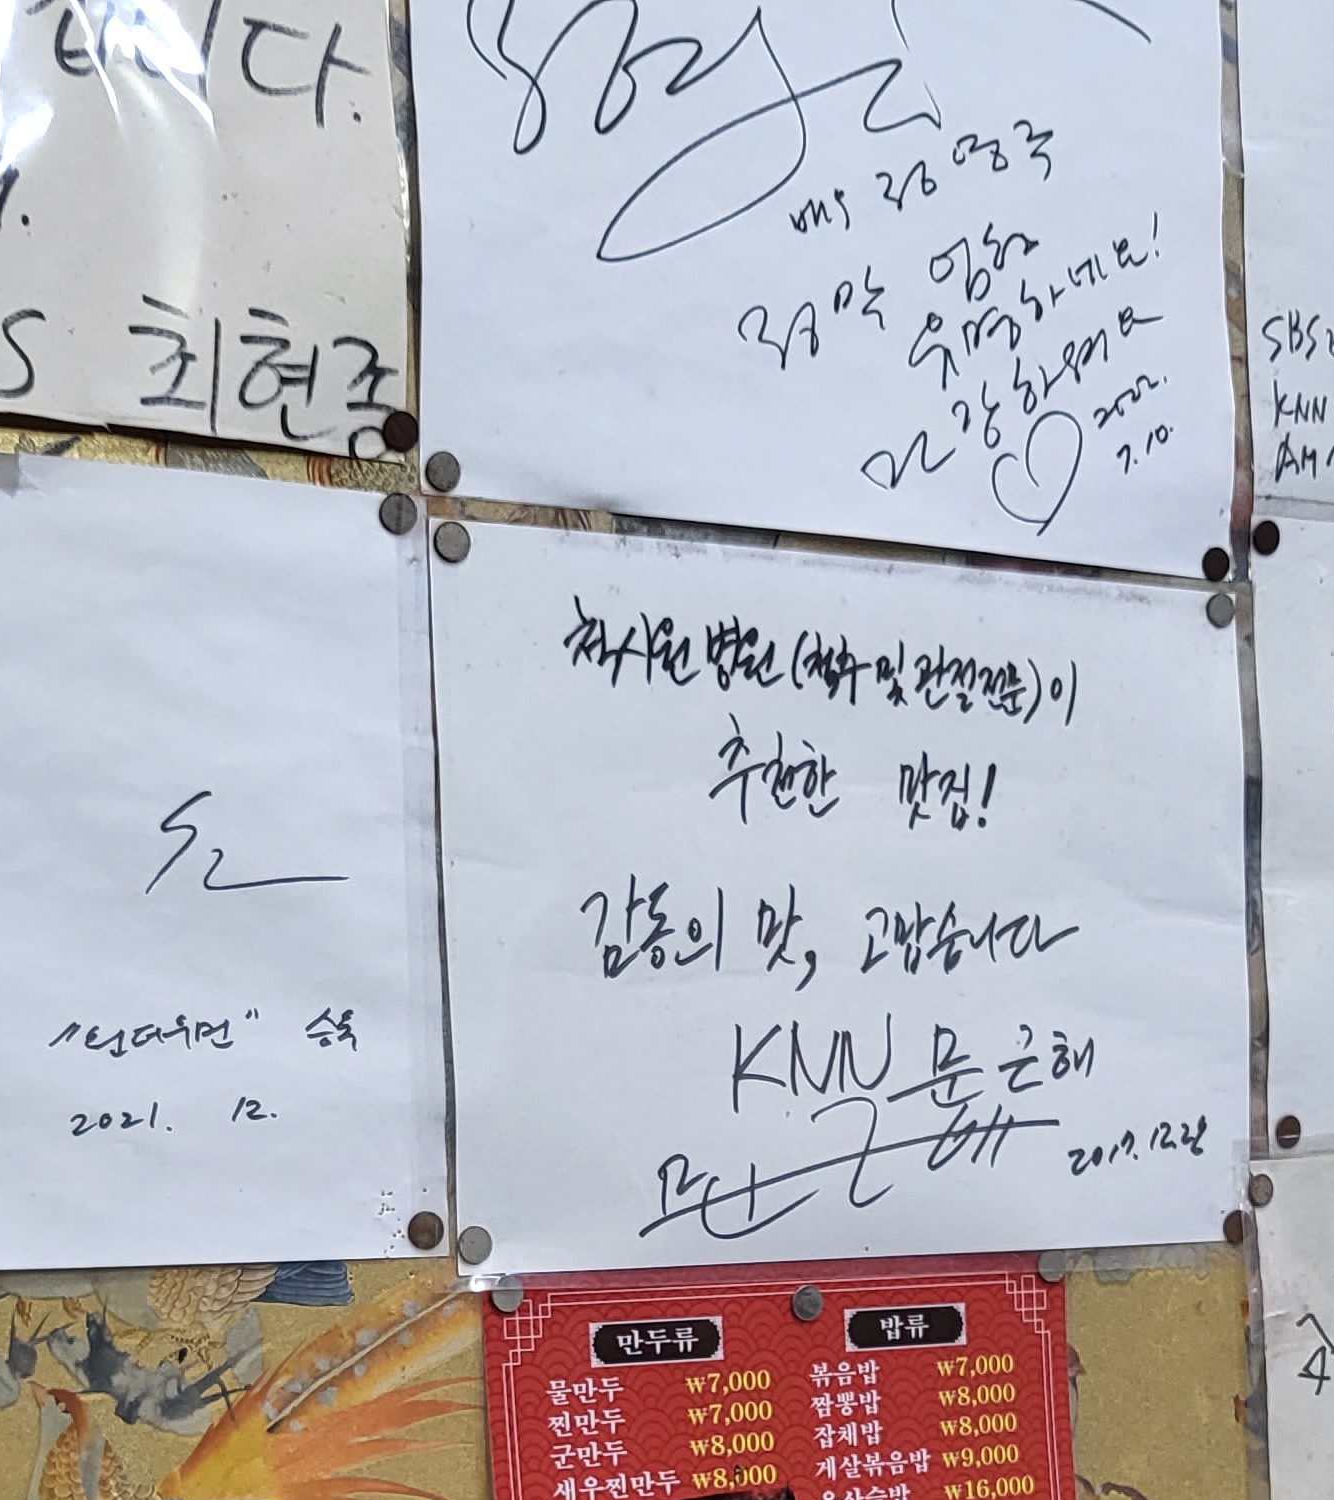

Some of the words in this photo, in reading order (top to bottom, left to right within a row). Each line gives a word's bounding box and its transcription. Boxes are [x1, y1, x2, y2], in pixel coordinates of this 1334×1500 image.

[581, 876, 725, 980] 감동의
[757, 885, 820, 991] 맛,
[861, 902, 1080, 978] 고맙습니다
[731, 1012, 893, 1114] KNN
[70, 1101, 173, 1137] 2021.
[231, 1096, 279, 1123] 12.
[616, 1326, 699, 1357] 만두류
[879, 1314, 930, 1341] 밥류
[546, 1376, 624, 1406] 물만두
[685, 1369, 771, 1396] ₩7,000
[809, 1359, 880, 1387] 볶음밥
[936, 1354, 1014, 1378] ₩7,000
[547, 1408, 626, 1438] 찐만두
[687, 1400, 772, 1426] ₩7,000
[810, 1389, 881, 1419] 짬뽕밥
[938, 1383, 1016, 1407] ₩8,000
[813, 1420, 883, 1449] 잡채밥
[940, 1412, 1018, 1437] ₩8,000
[549, 1440, 628, 1470] 군만두
[689, 1431, 774, 1458] ₩8,000
[815, 1447, 931, 1481] 게살볶음밥
[942, 1444, 1019, 1469] ₩9,000
[944, 1474, 1035, 1500] ₩16,000
